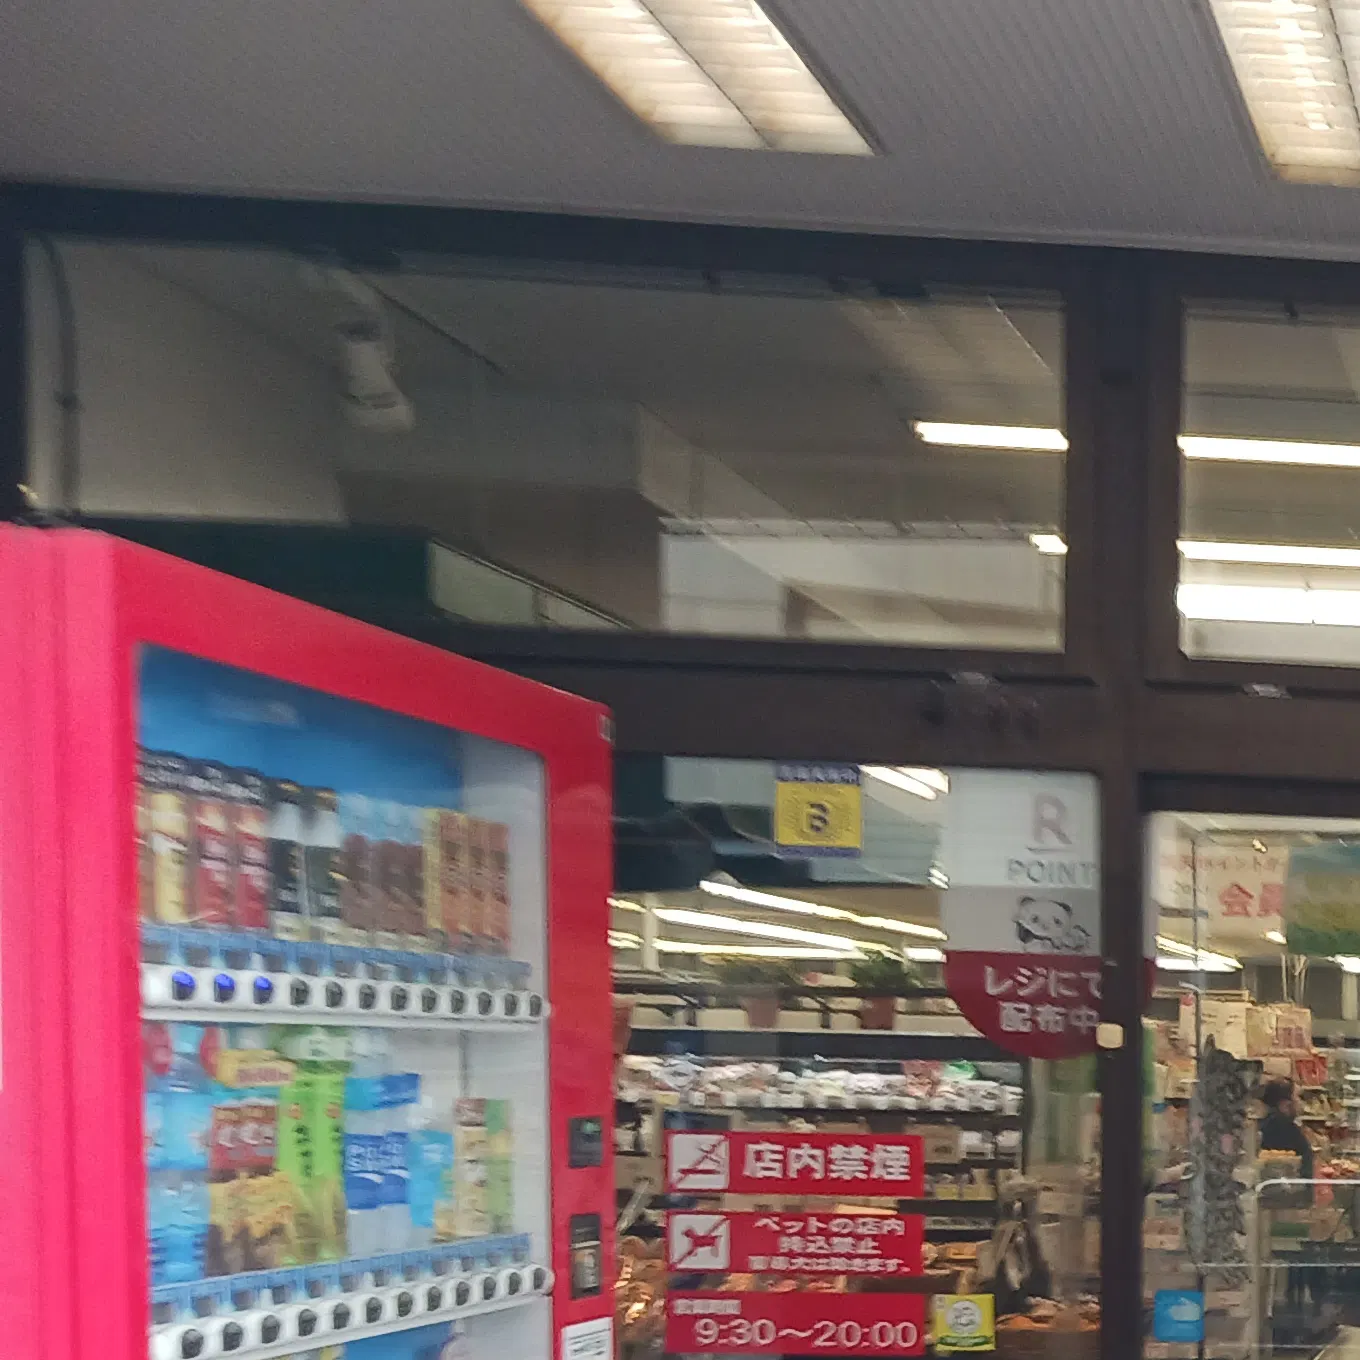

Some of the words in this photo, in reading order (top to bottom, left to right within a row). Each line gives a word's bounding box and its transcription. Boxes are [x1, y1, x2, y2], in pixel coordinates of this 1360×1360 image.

[1034, 793, 1072, 845] R
[1007, 860, 1099, 886] POINT
[984, 965, 1102, 998] レジにて
[1000, 1002, 1099, 1034] 配布中
[742, 1140, 911, 1181] 店内禁煙
[753, 1216, 905, 1236] ペットの店内
